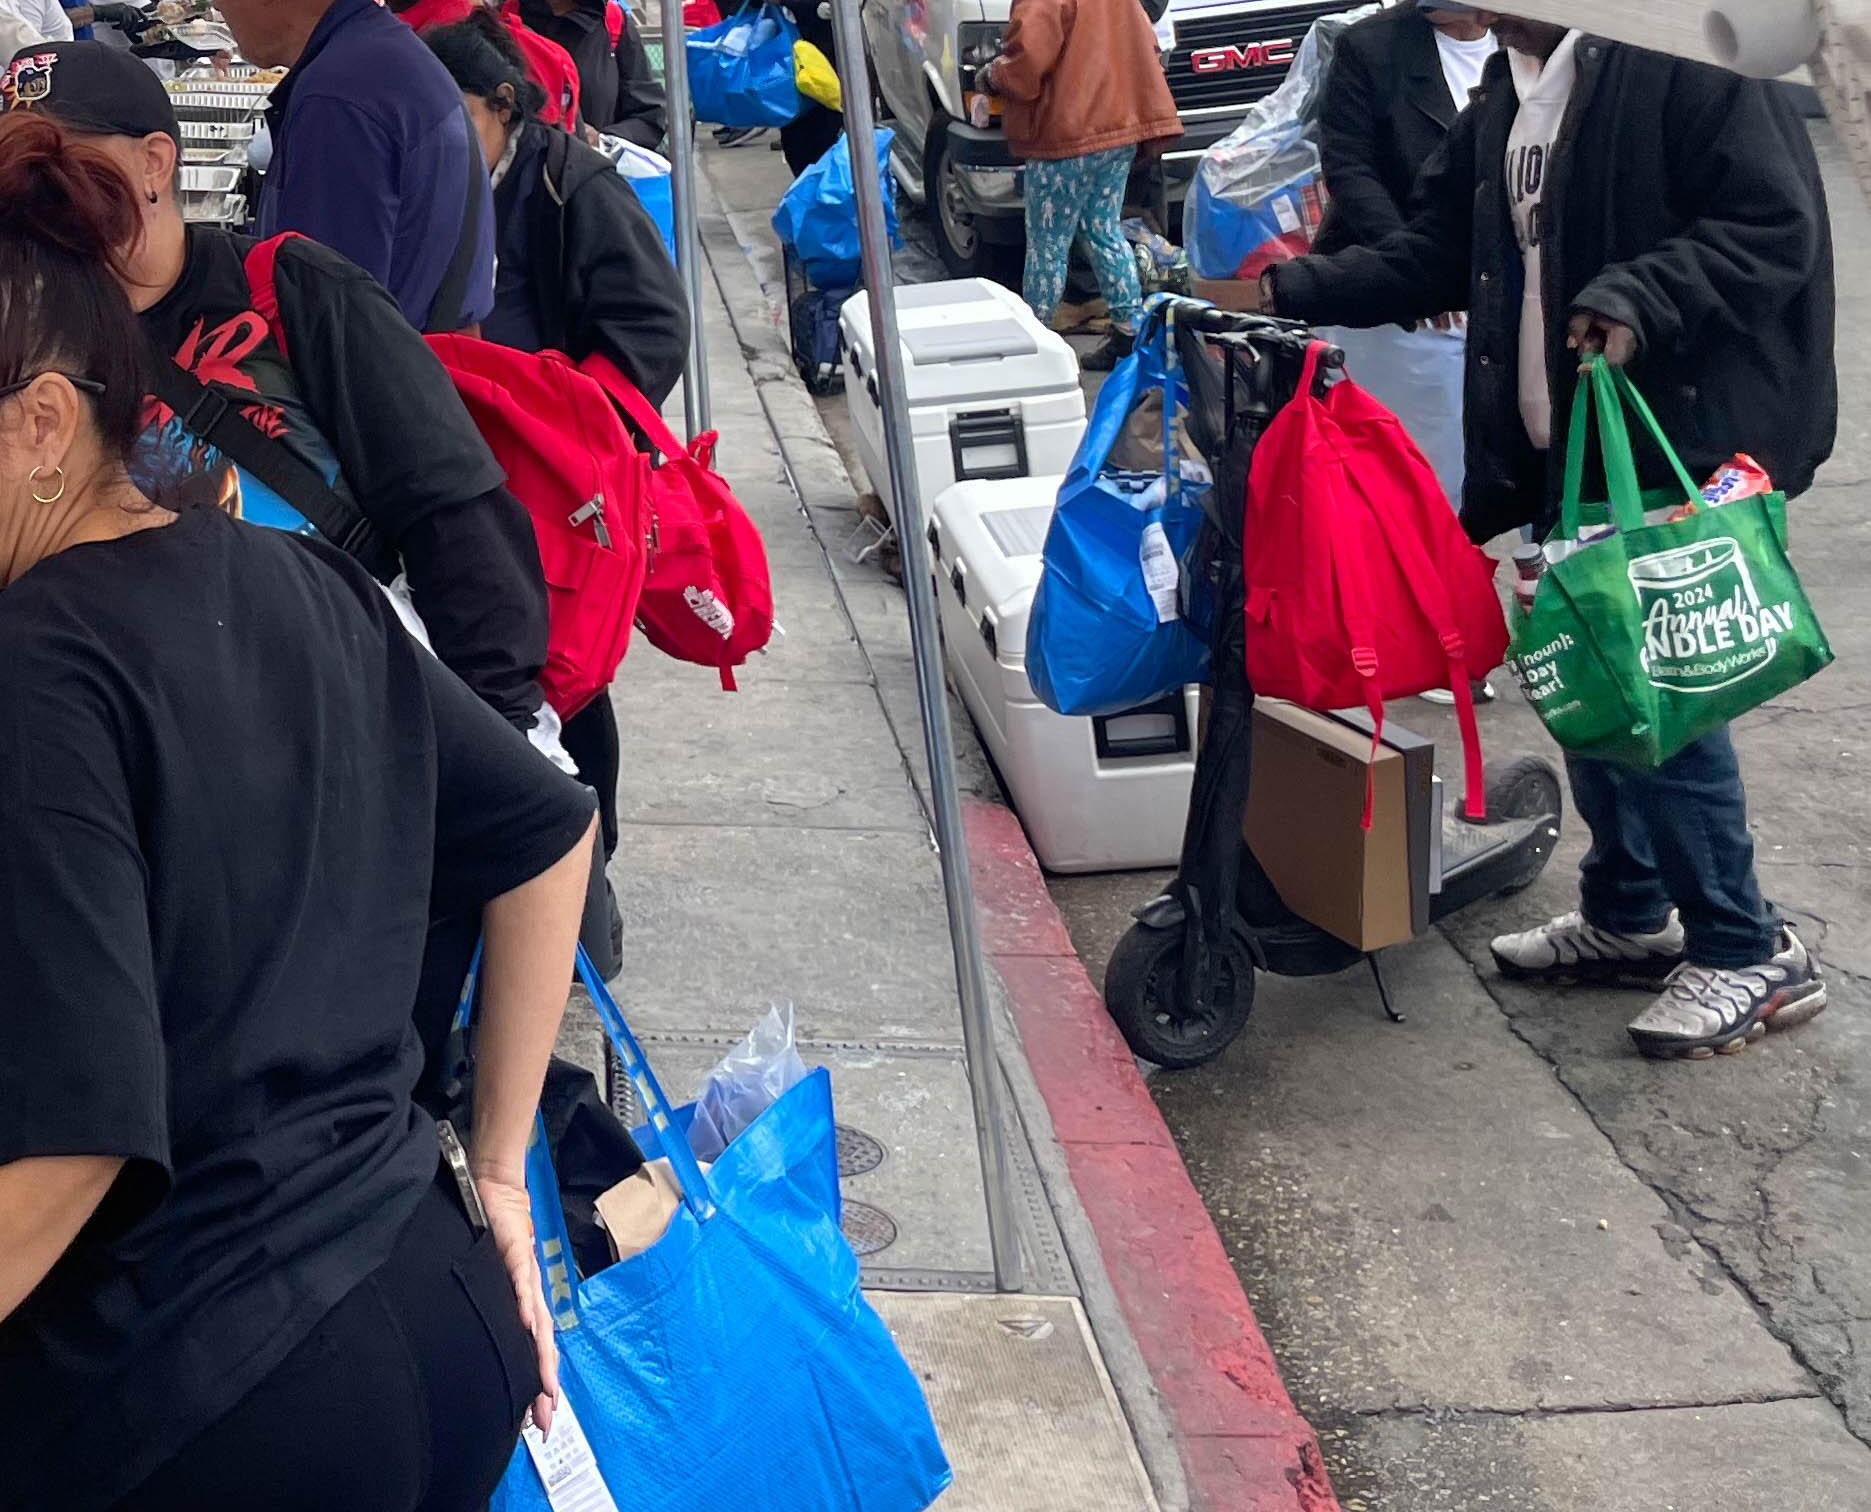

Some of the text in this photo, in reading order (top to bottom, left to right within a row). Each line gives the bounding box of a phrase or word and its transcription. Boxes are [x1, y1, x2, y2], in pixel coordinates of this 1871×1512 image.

[1191, 38, 1294, 73] GMC
[1642, 584, 1746, 634] Annual
[1672, 583, 1713, 609] 2024
[1645, 601, 1793, 661] NDLE DAY
